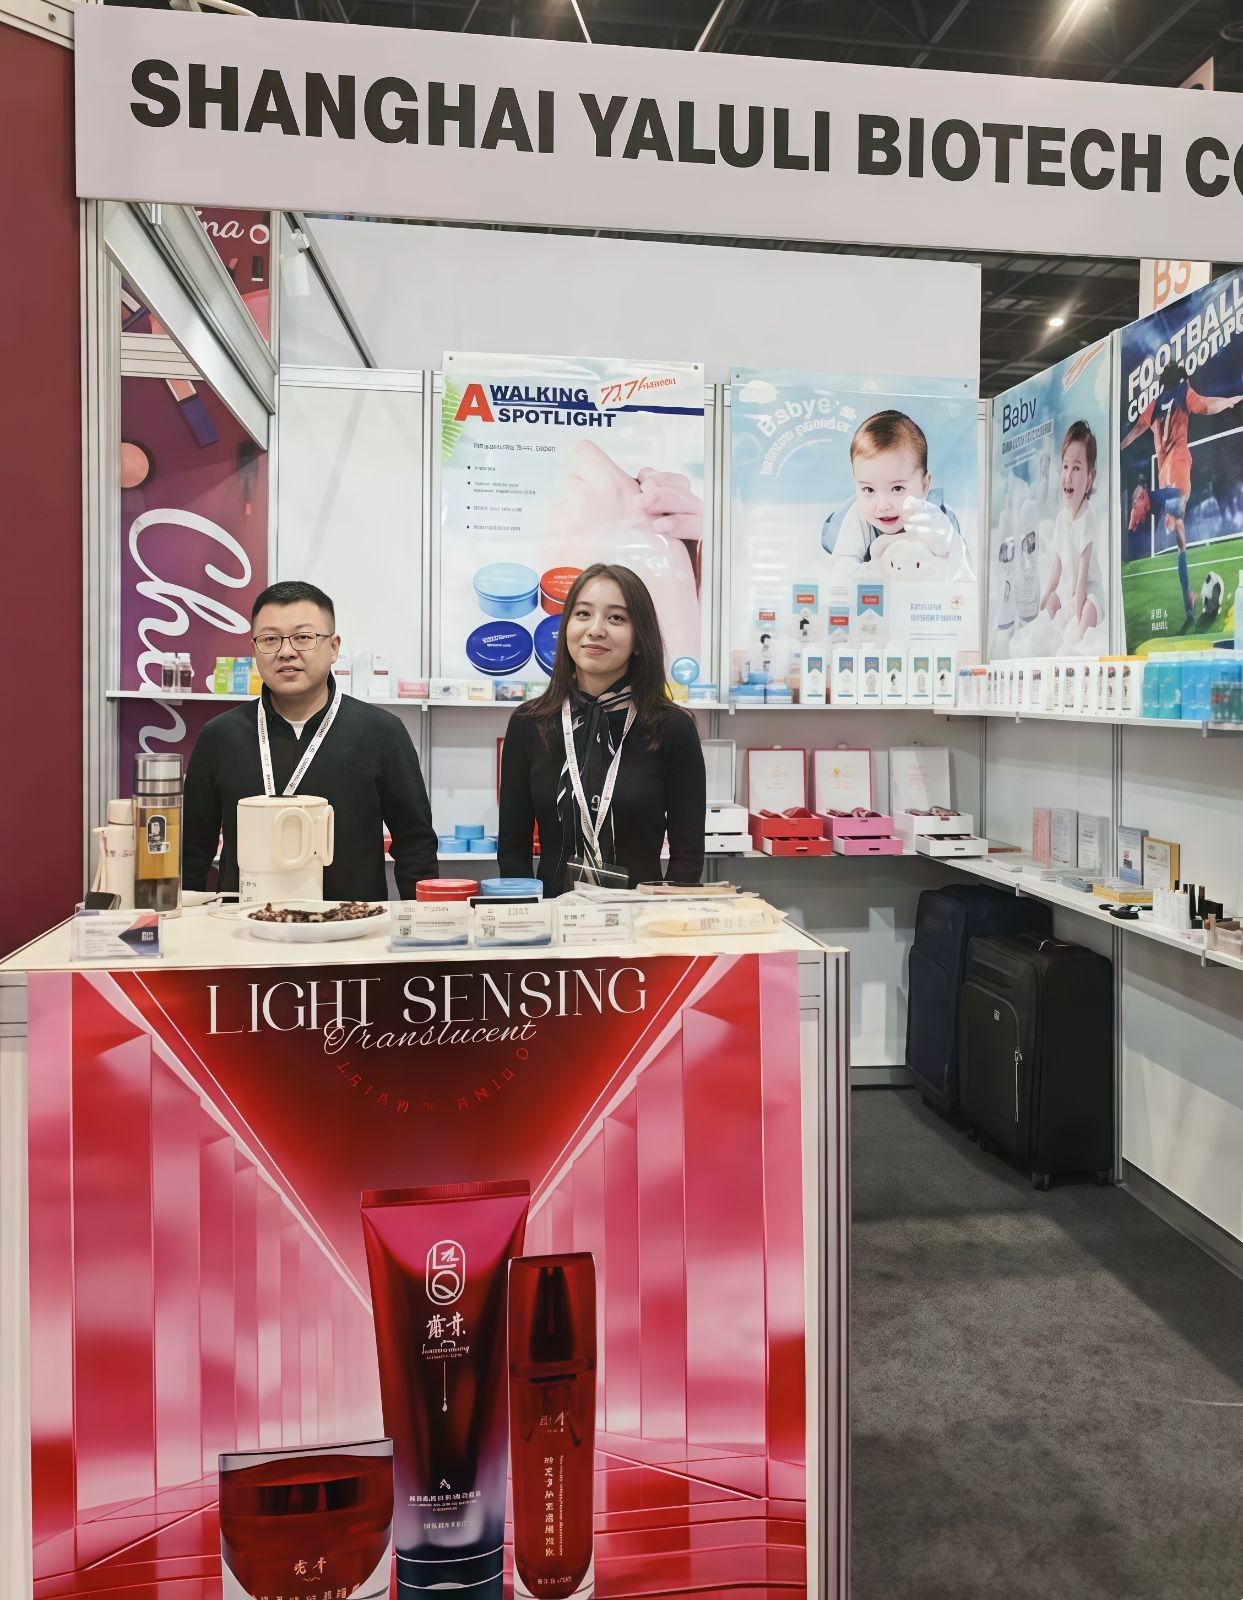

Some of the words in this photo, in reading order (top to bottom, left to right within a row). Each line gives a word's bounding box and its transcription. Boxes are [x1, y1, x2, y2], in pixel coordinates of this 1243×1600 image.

[130, 59, 554, 154] SHANGHAI
[578, 93, 830, 172] YALULI
[857, 113, 1163, 193] BIOTECH
[1185, 136, 1243, 198] C
[1128, 277, 1243, 403] FOOTBALL
[454, 383, 495, 423] A
[489, 384, 589, 403] WALKING
[497, 408, 617, 428] SPOTLIGHT
[206, 976, 381, 1035] LIGHT
[402, 967, 647, 1025] SENSING
[323, 1016, 537, 1055] Translucent
